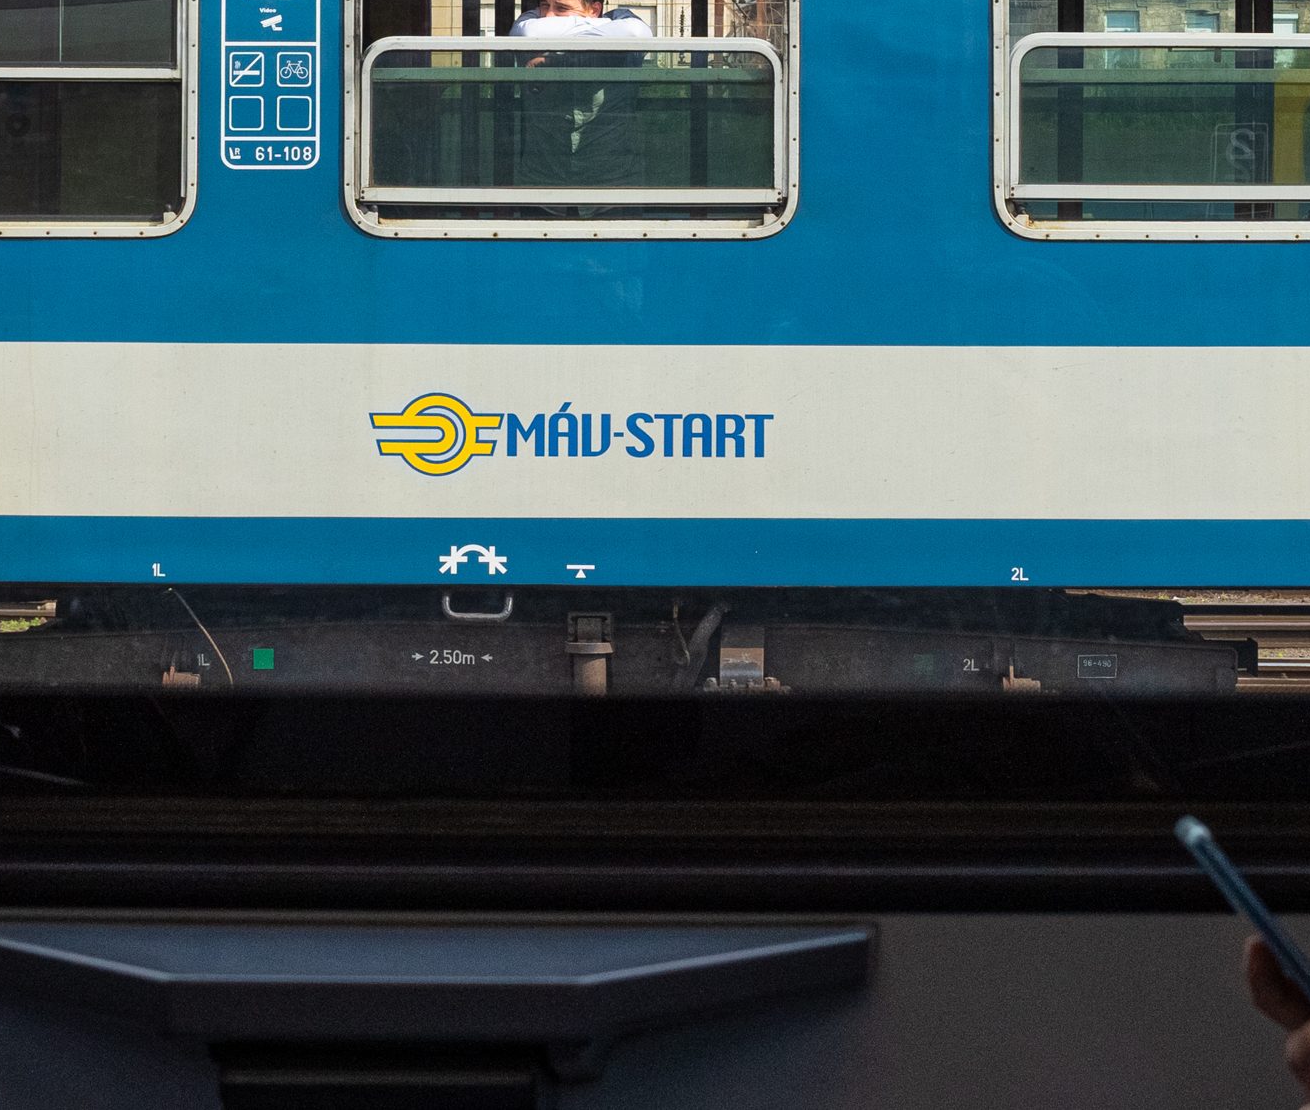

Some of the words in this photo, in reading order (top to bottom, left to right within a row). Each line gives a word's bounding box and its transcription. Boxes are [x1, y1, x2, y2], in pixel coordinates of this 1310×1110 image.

[255, 146, 312, 161] 61-108
[506, 401, 775, 458] MÁV-START
[151, 563, 166, 577] 1L
[1010, 567, 1029, 581] 2L
[429, 649, 475, 665] 2.50m
[963, 658, 980, 672] 2L
